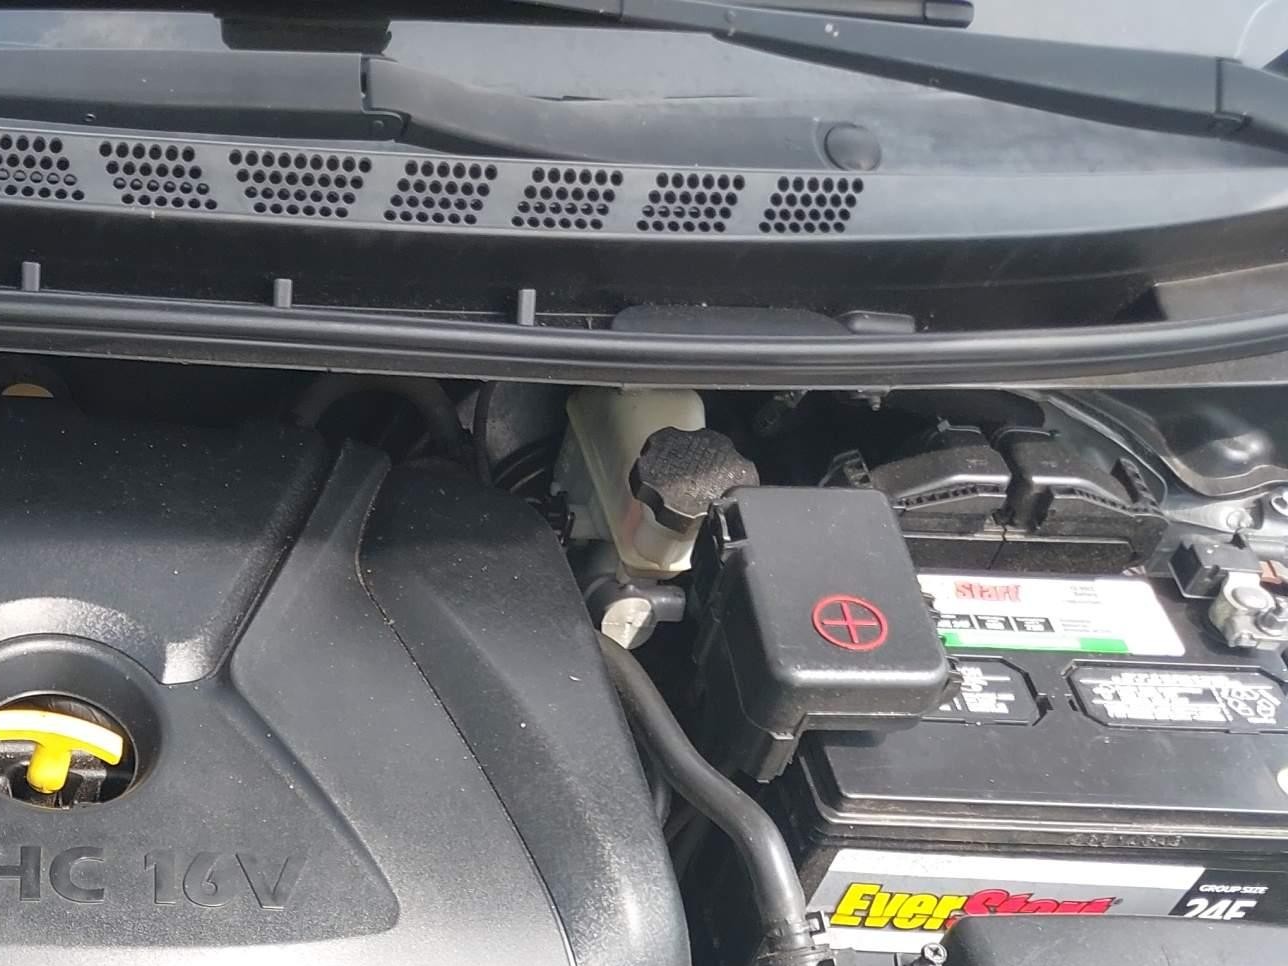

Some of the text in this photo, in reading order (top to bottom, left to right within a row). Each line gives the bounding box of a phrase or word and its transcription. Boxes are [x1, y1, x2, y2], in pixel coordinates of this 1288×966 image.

[144, 848, 309, 910] 16V
[1199, 884, 1269, 895] GROUP SIZE
